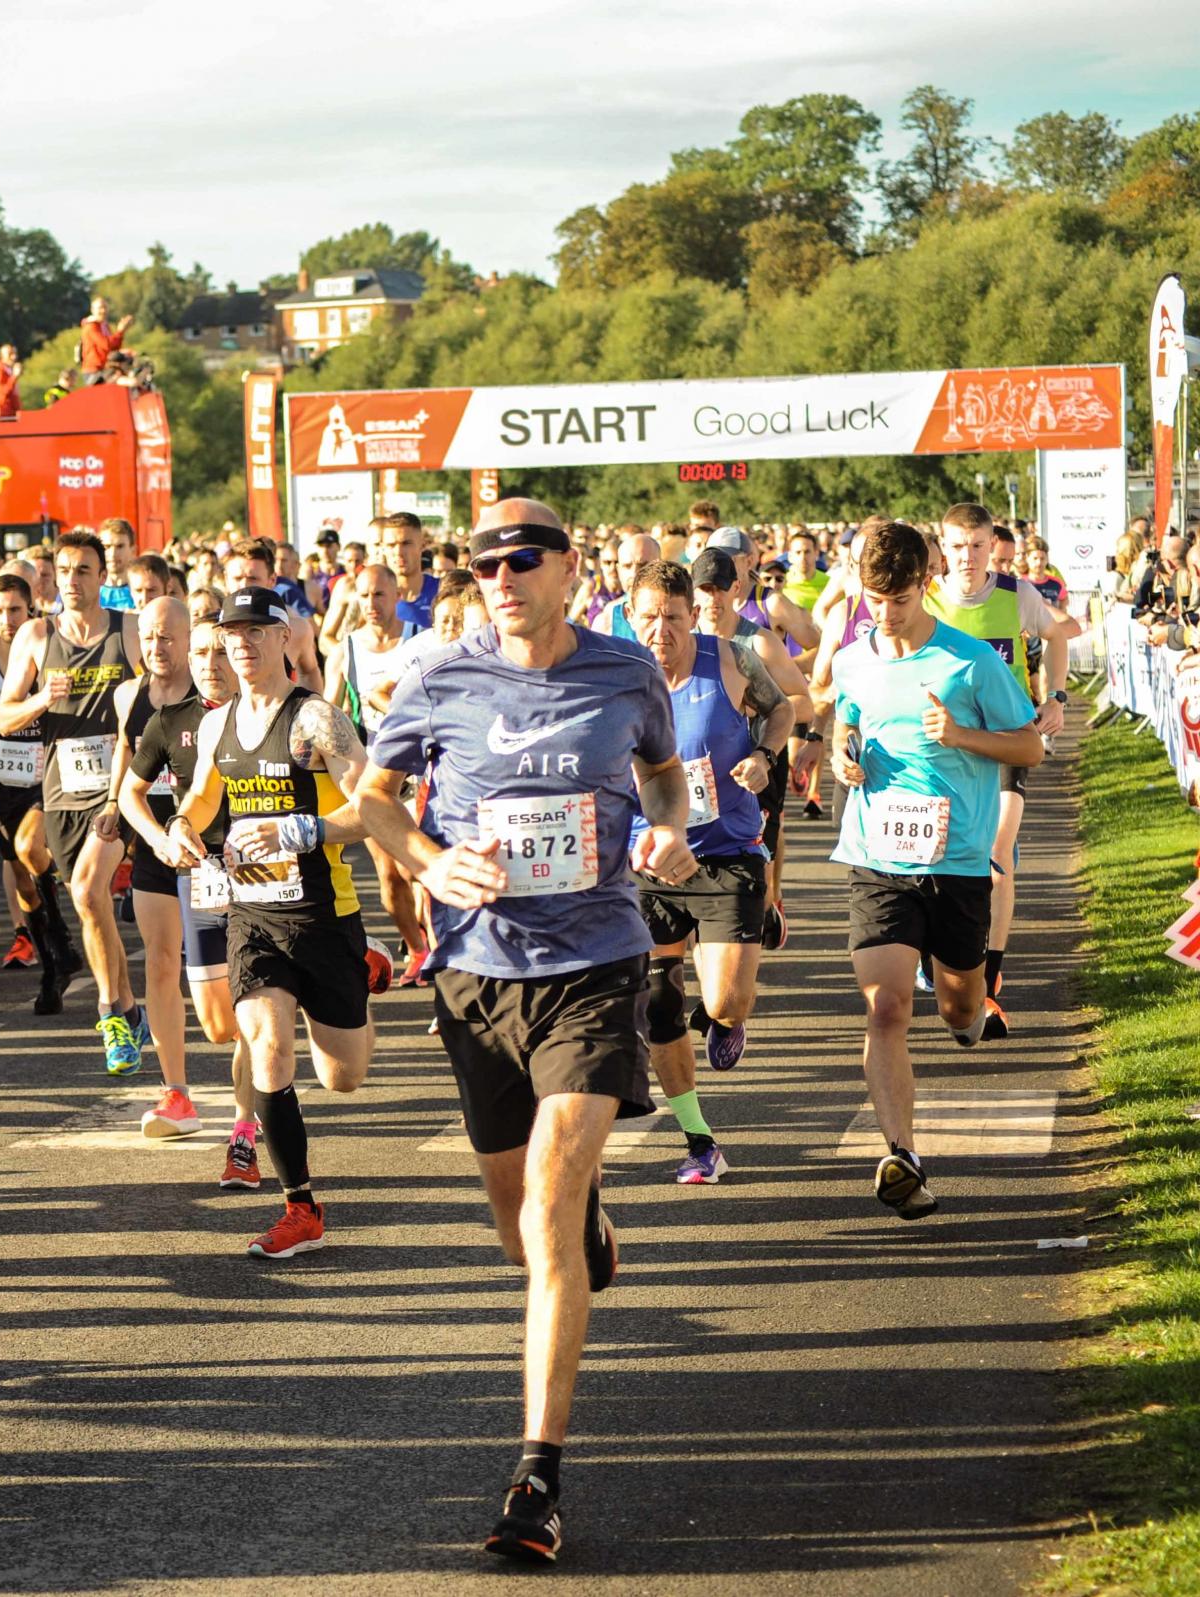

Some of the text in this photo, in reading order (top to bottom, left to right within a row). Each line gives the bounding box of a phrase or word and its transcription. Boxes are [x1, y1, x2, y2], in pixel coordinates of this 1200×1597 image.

[365, 420, 420, 432] ESSAR
[500, 401, 889, 446] START Good Luck
[251, 383, 273, 489] ELITE
[59, 456, 103, 470] Hop On
[59, 474, 104, 488] Hop Off
[1062, 471, 1102, 479] ESSAR
[71, 744, 104, 753] ESSAR
[75, 758, 103, 771] 811
[258, 760, 290, 777] Tom
[516, 753, 580, 776] AIR
[888, 805, 928, 813] ESSAR
[508, 811, 567, 825] ESSAR
[883, 821, 933, 838] 1880
[503, 834, 577, 860] 1872
[896, 841, 916, 851] ZAK
[532, 864, 550, 878] ED
[278, 889, 300, 899] 1507
